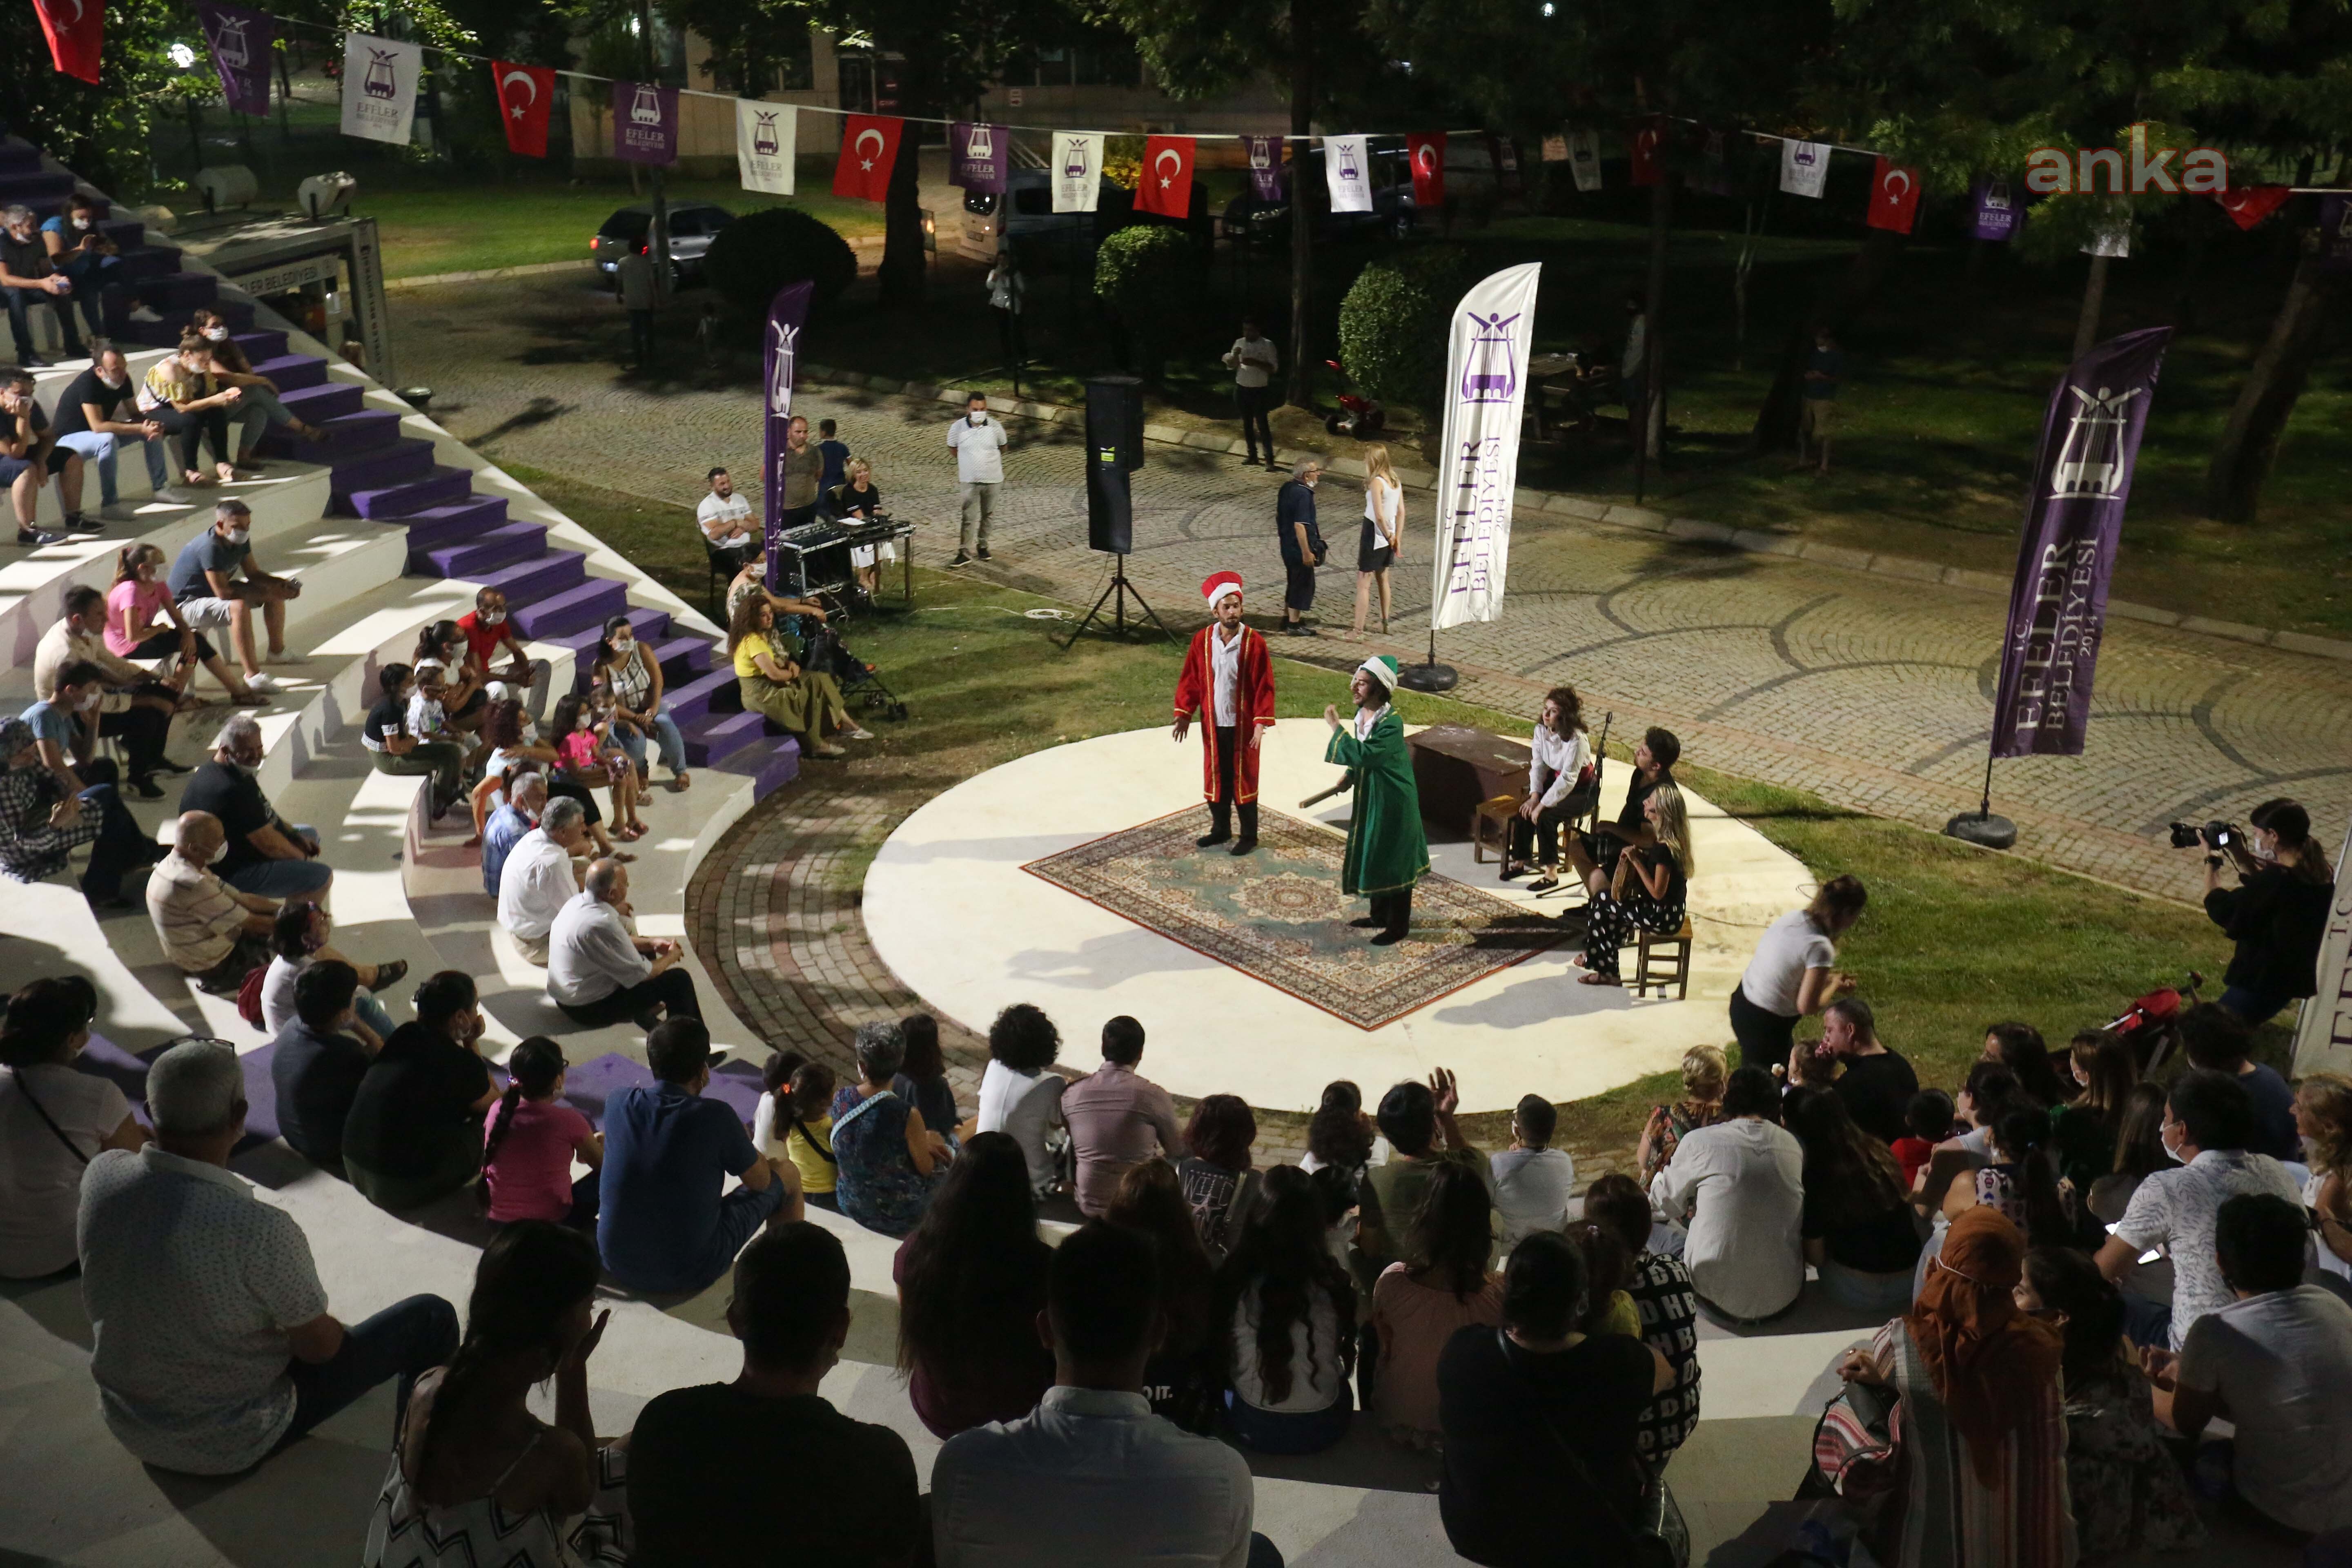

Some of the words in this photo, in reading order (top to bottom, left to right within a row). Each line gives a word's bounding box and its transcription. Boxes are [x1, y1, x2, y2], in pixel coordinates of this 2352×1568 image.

[626, 128, 665, 142] EFELER
[1980, 212, 2012, 223] EFELER
[1450, 437, 1482, 593] EFELER
[1472, 437, 1500, 590] BELEDİYESİ
[1495, 496, 1506, 532] 2014
[2015, 535, 2074, 735] EFELER
[2045, 536, 2099, 731] BELEDİYESİ
[2079, 615, 2098, 657] 2014
